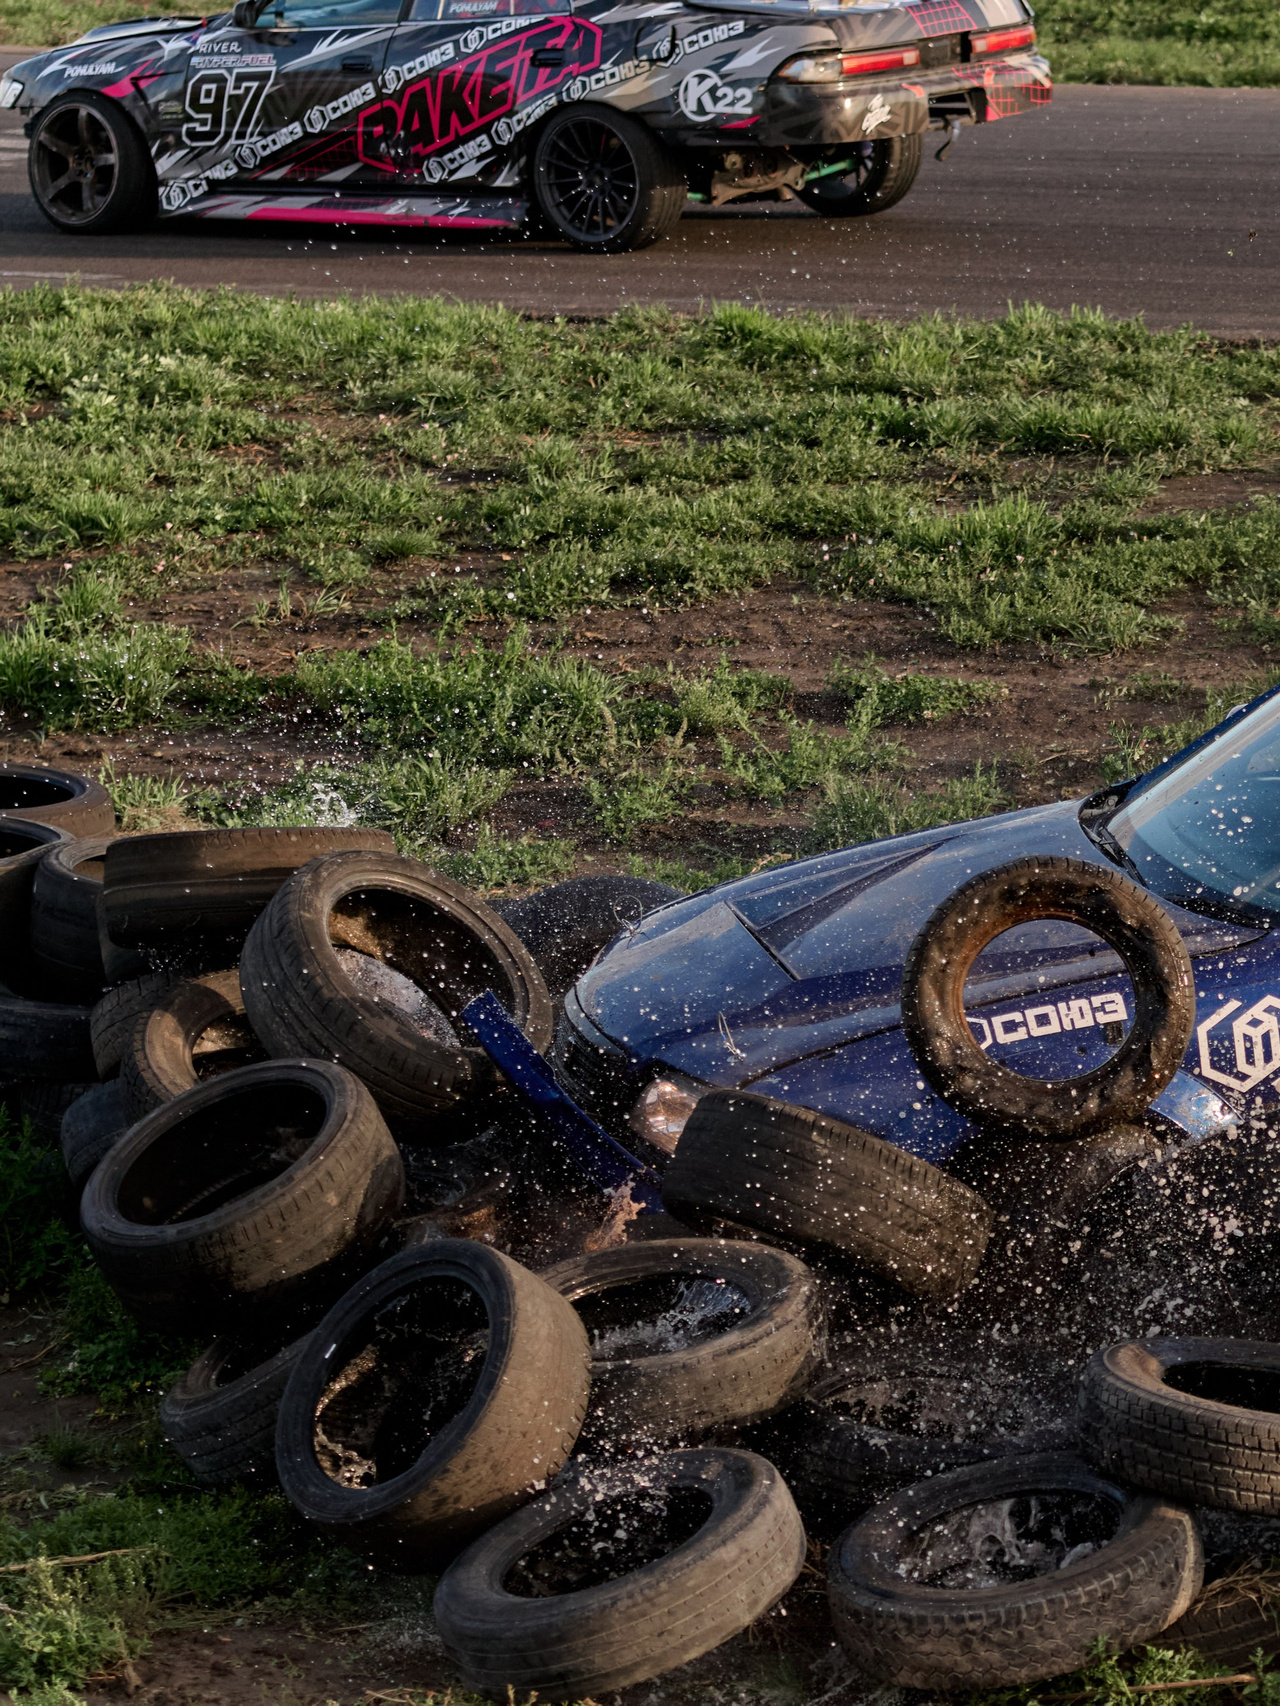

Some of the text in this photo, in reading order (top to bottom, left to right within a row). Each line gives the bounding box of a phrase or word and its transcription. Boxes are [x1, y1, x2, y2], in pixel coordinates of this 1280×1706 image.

[199, 41, 242, 53] RIVER
[242, 53, 277, 67] FUEL
[182, 66, 277, 146] 97
[256, 120, 304, 157] СОЮЗ
[327, 81, 377, 120] СОЮЗ
[402, 42, 455, 81] СОЮЗ
[487, 17, 546, 40] СОЮ
[441, 134, 493, 169] СОЮЗ
[590, 55, 653, 91] СОЮЗ
[684, 20, 745, 54] СОЮЗ
[992, 992, 1128, 1045] СОЮЗ
